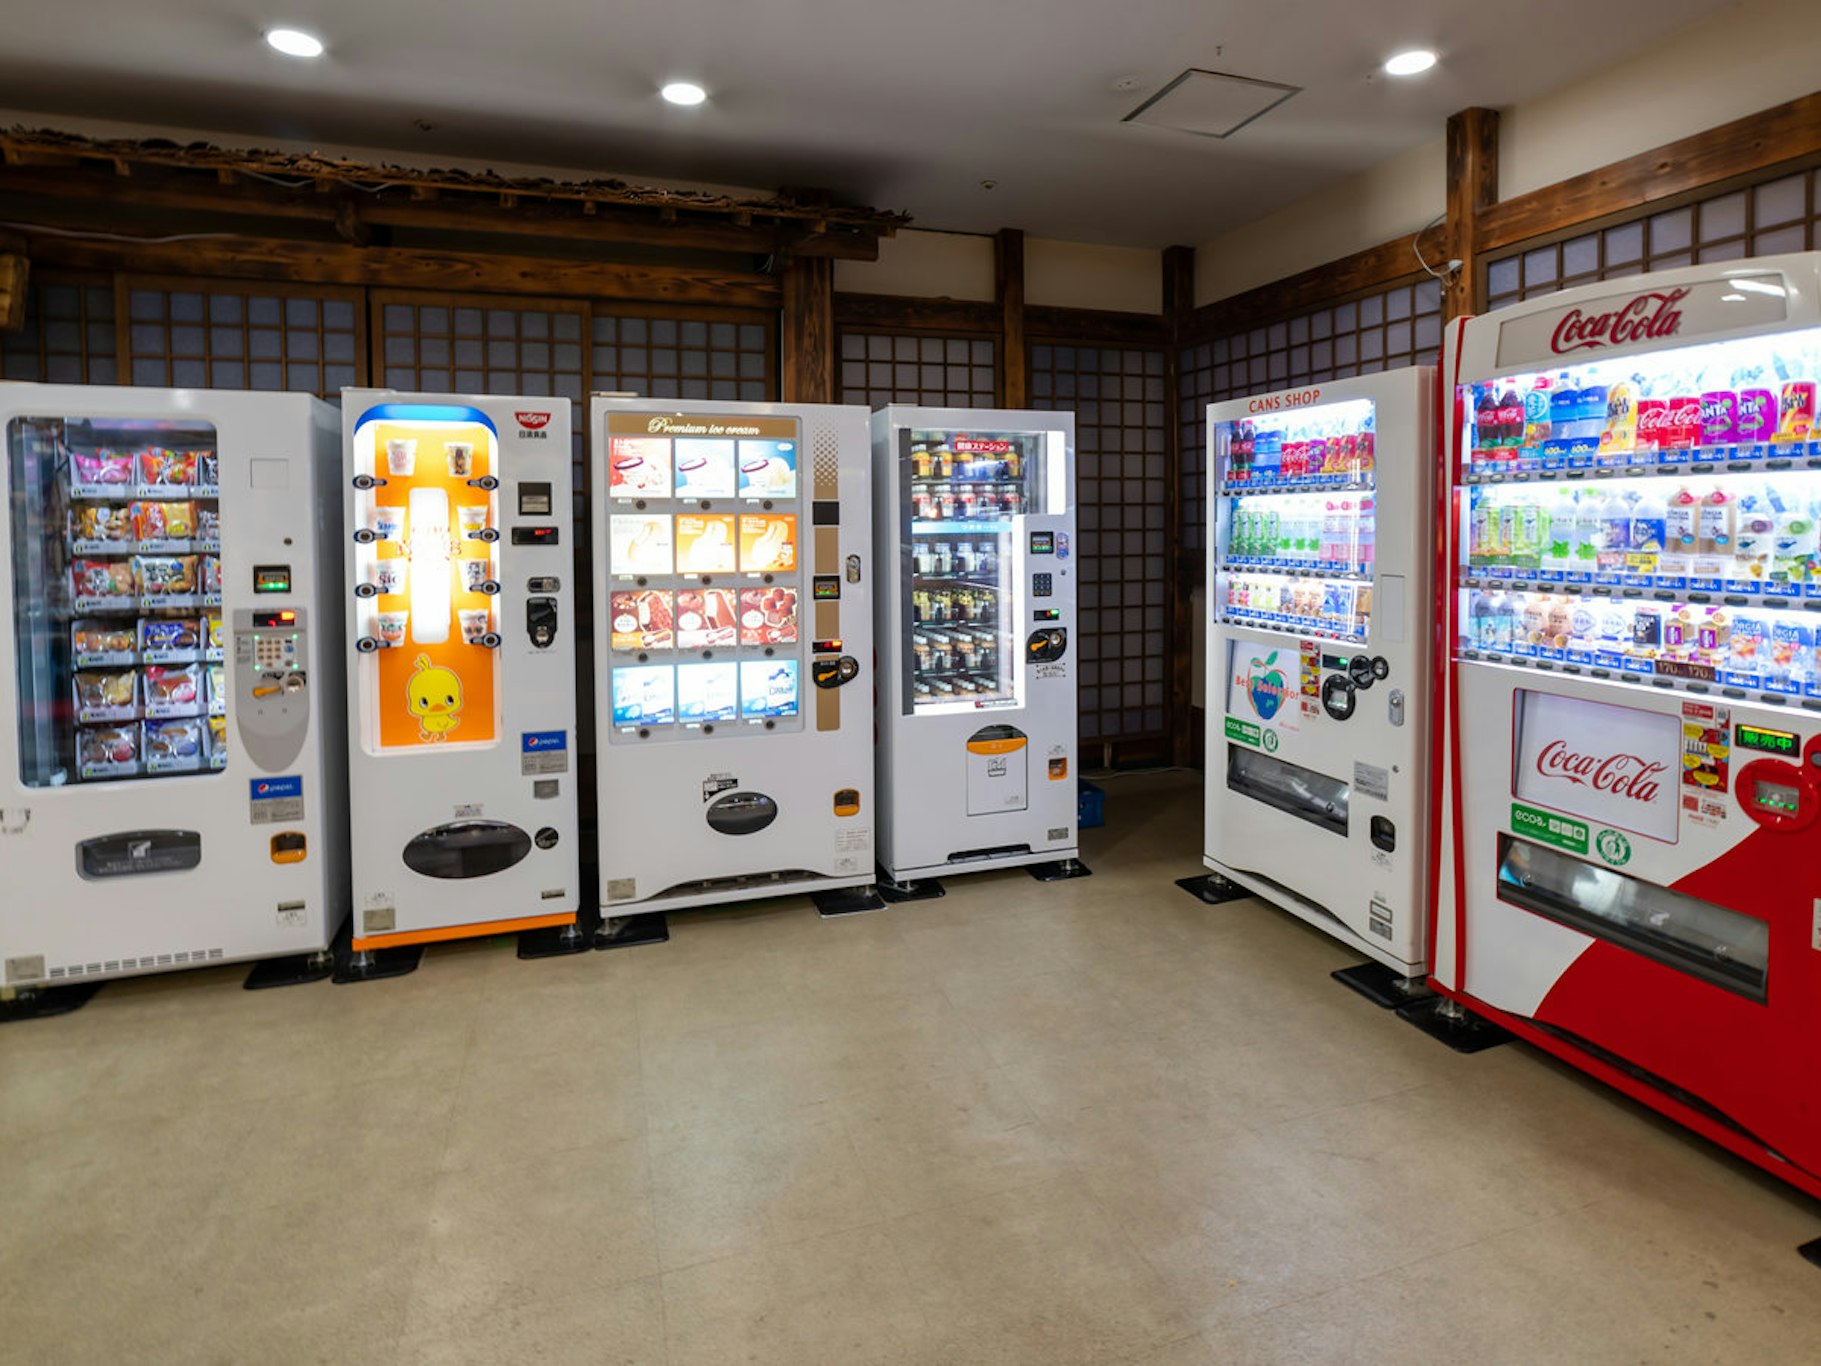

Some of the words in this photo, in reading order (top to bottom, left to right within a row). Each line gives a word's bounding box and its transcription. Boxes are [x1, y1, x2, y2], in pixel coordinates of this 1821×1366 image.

[1551, 287, 1692, 354] Coca-Cola
[1249, 396, 1280, 413] CANS
[1285, 389, 1320, 408] SHOP
[518, 414, 548, 425] NISSIN
[647, 416, 708, 434] Premium
[708, 424, 725, 435] ice
[725, 426, 760, 436] cream
[1743, 731, 1793, 750] 販売中
[1537, 740, 1669, 802] Coca-Cola
